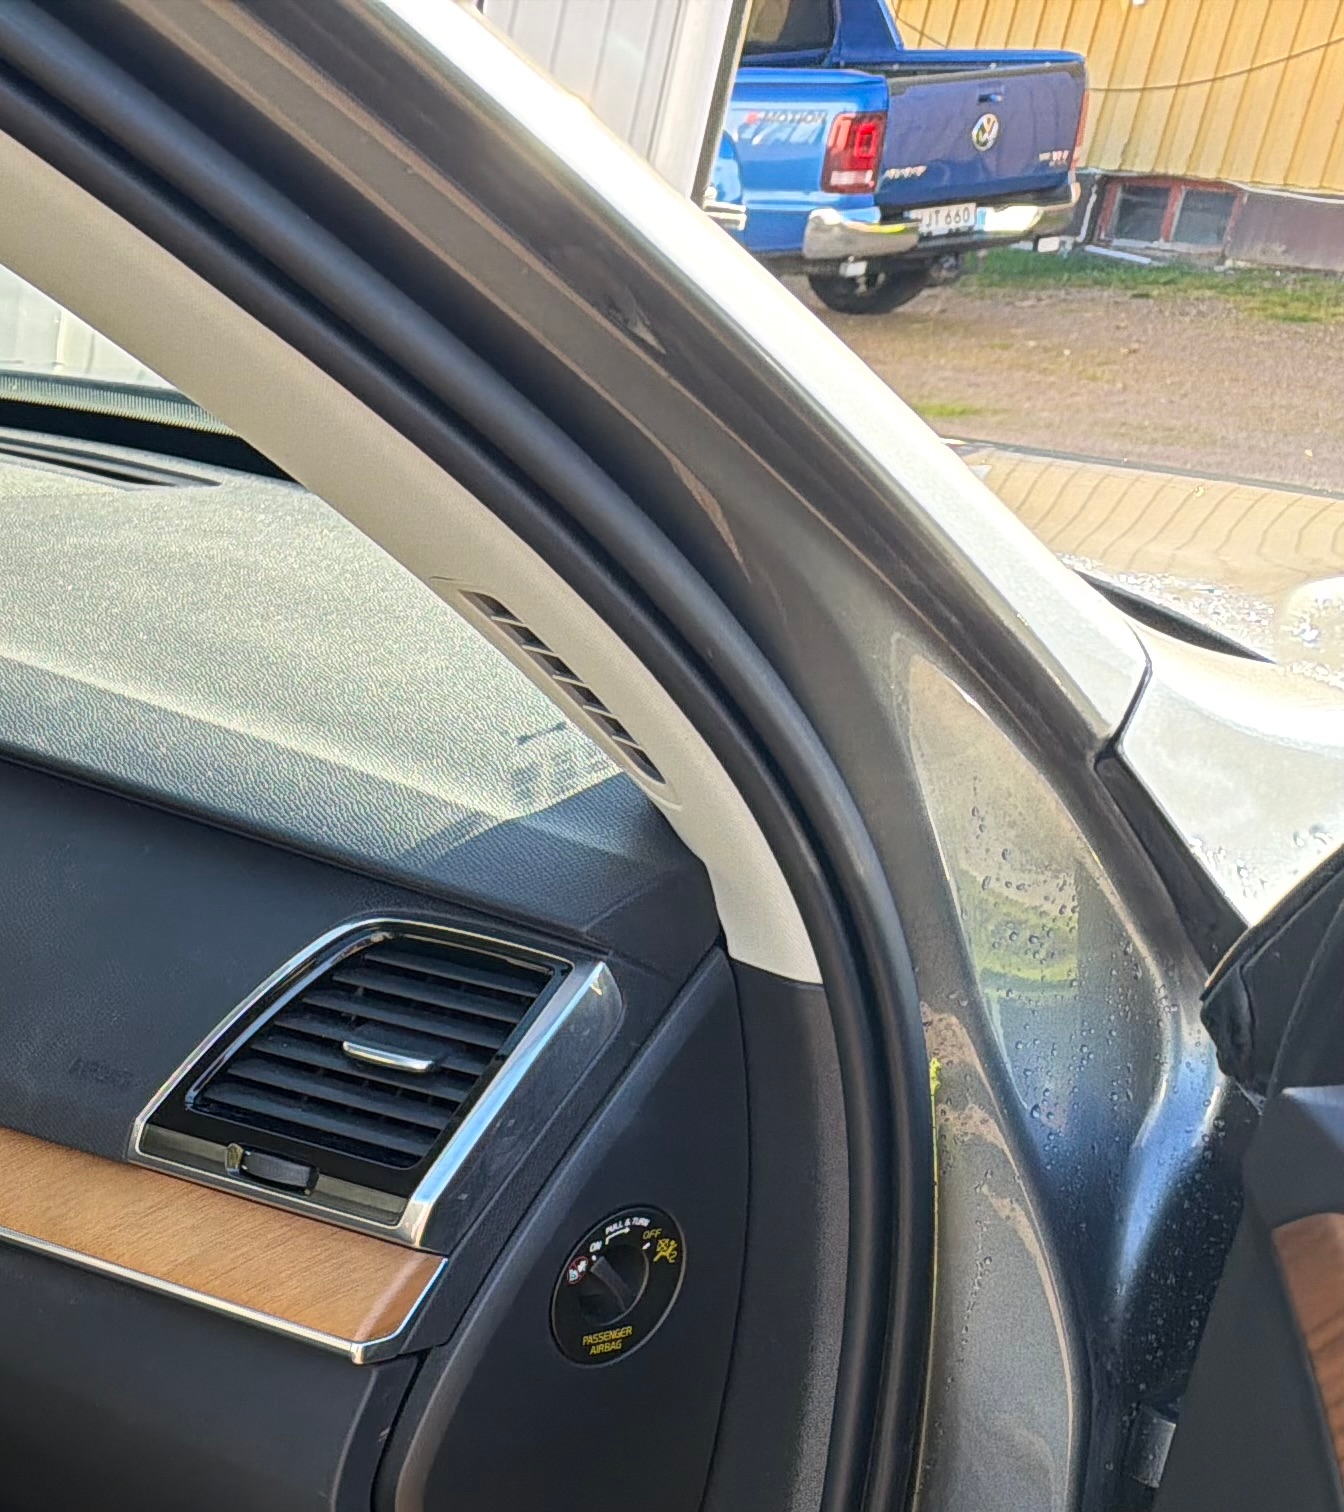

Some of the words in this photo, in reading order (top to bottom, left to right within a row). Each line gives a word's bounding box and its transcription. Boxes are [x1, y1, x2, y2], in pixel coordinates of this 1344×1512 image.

[944, 206, 971, 226] 660
[605, 1221, 624, 1235] PULL
[632, 1217, 650, 1227] TURN
[642, 1228, 663, 1240] OFF
[589, 1241, 602, 1252] ON
[582, 1326, 632, 1346] PASSENGER
[589, 1339, 622, 1355] AIRBAG
